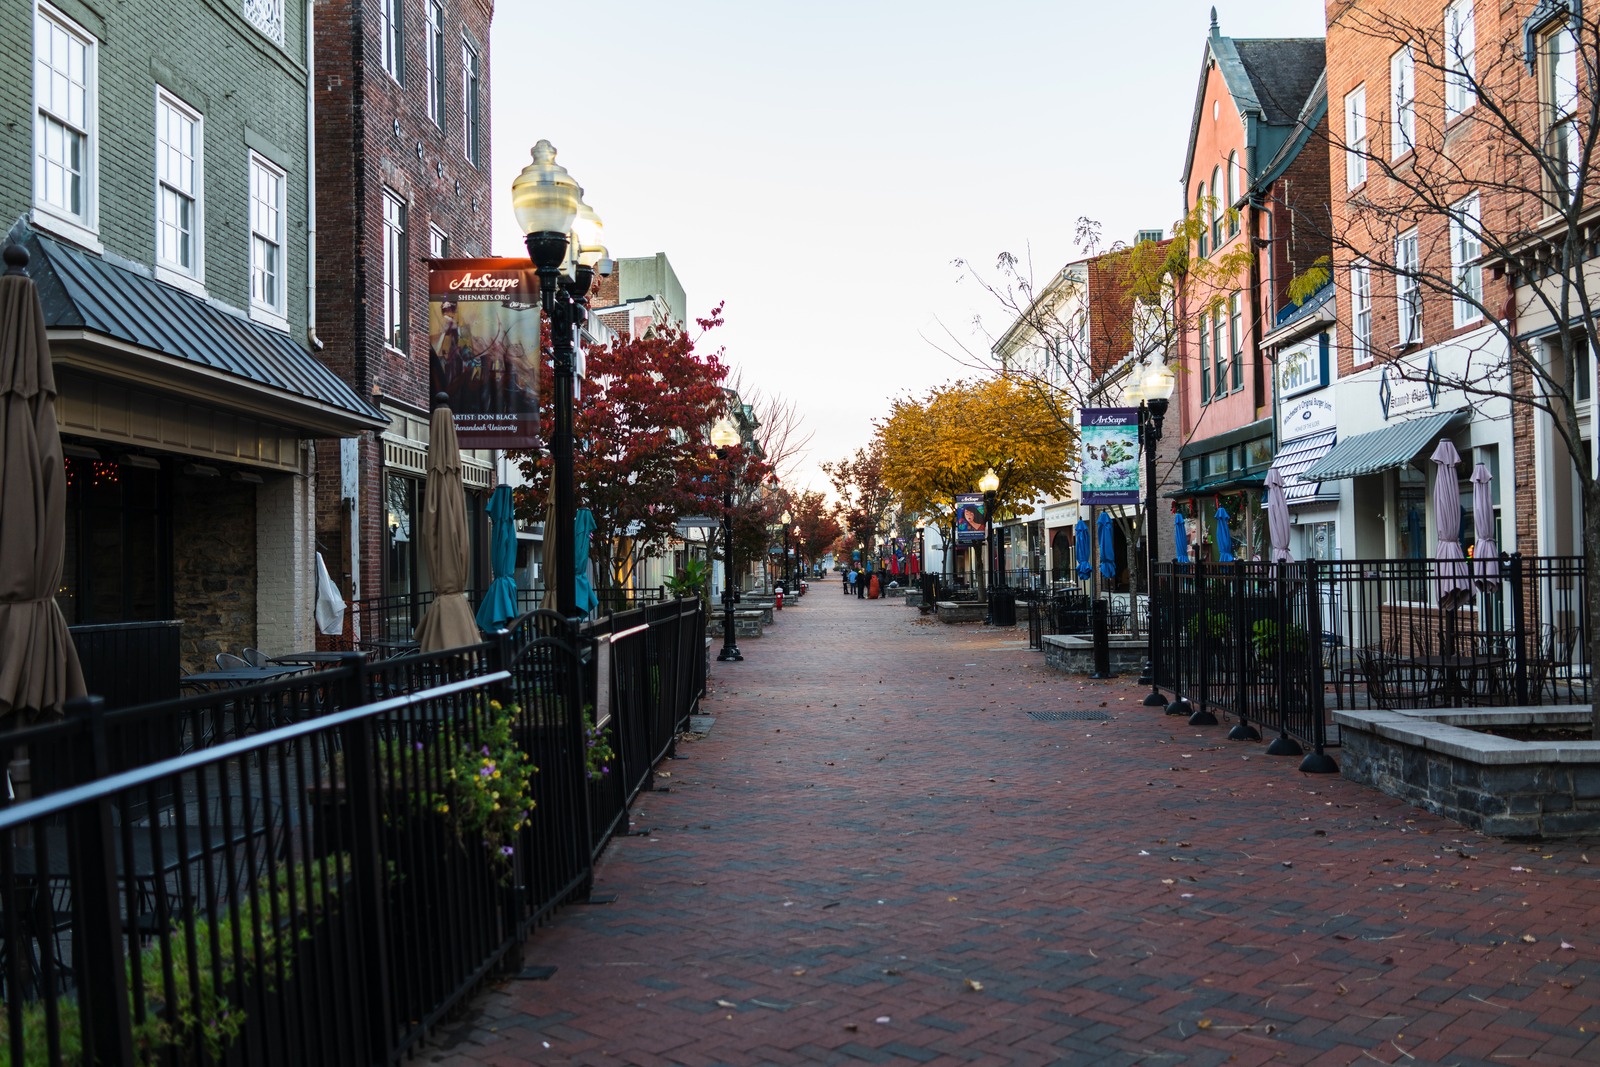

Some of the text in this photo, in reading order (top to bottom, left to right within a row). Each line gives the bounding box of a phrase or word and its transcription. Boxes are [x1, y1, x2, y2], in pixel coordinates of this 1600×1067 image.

[449, 272, 519, 292] ArtScape
[1282, 359, 1318, 390] GRILL
[1411, 389, 1428, 403] Glass
[1091, 415, 1128, 425] ArtScape
[487, 424, 518, 432] University
